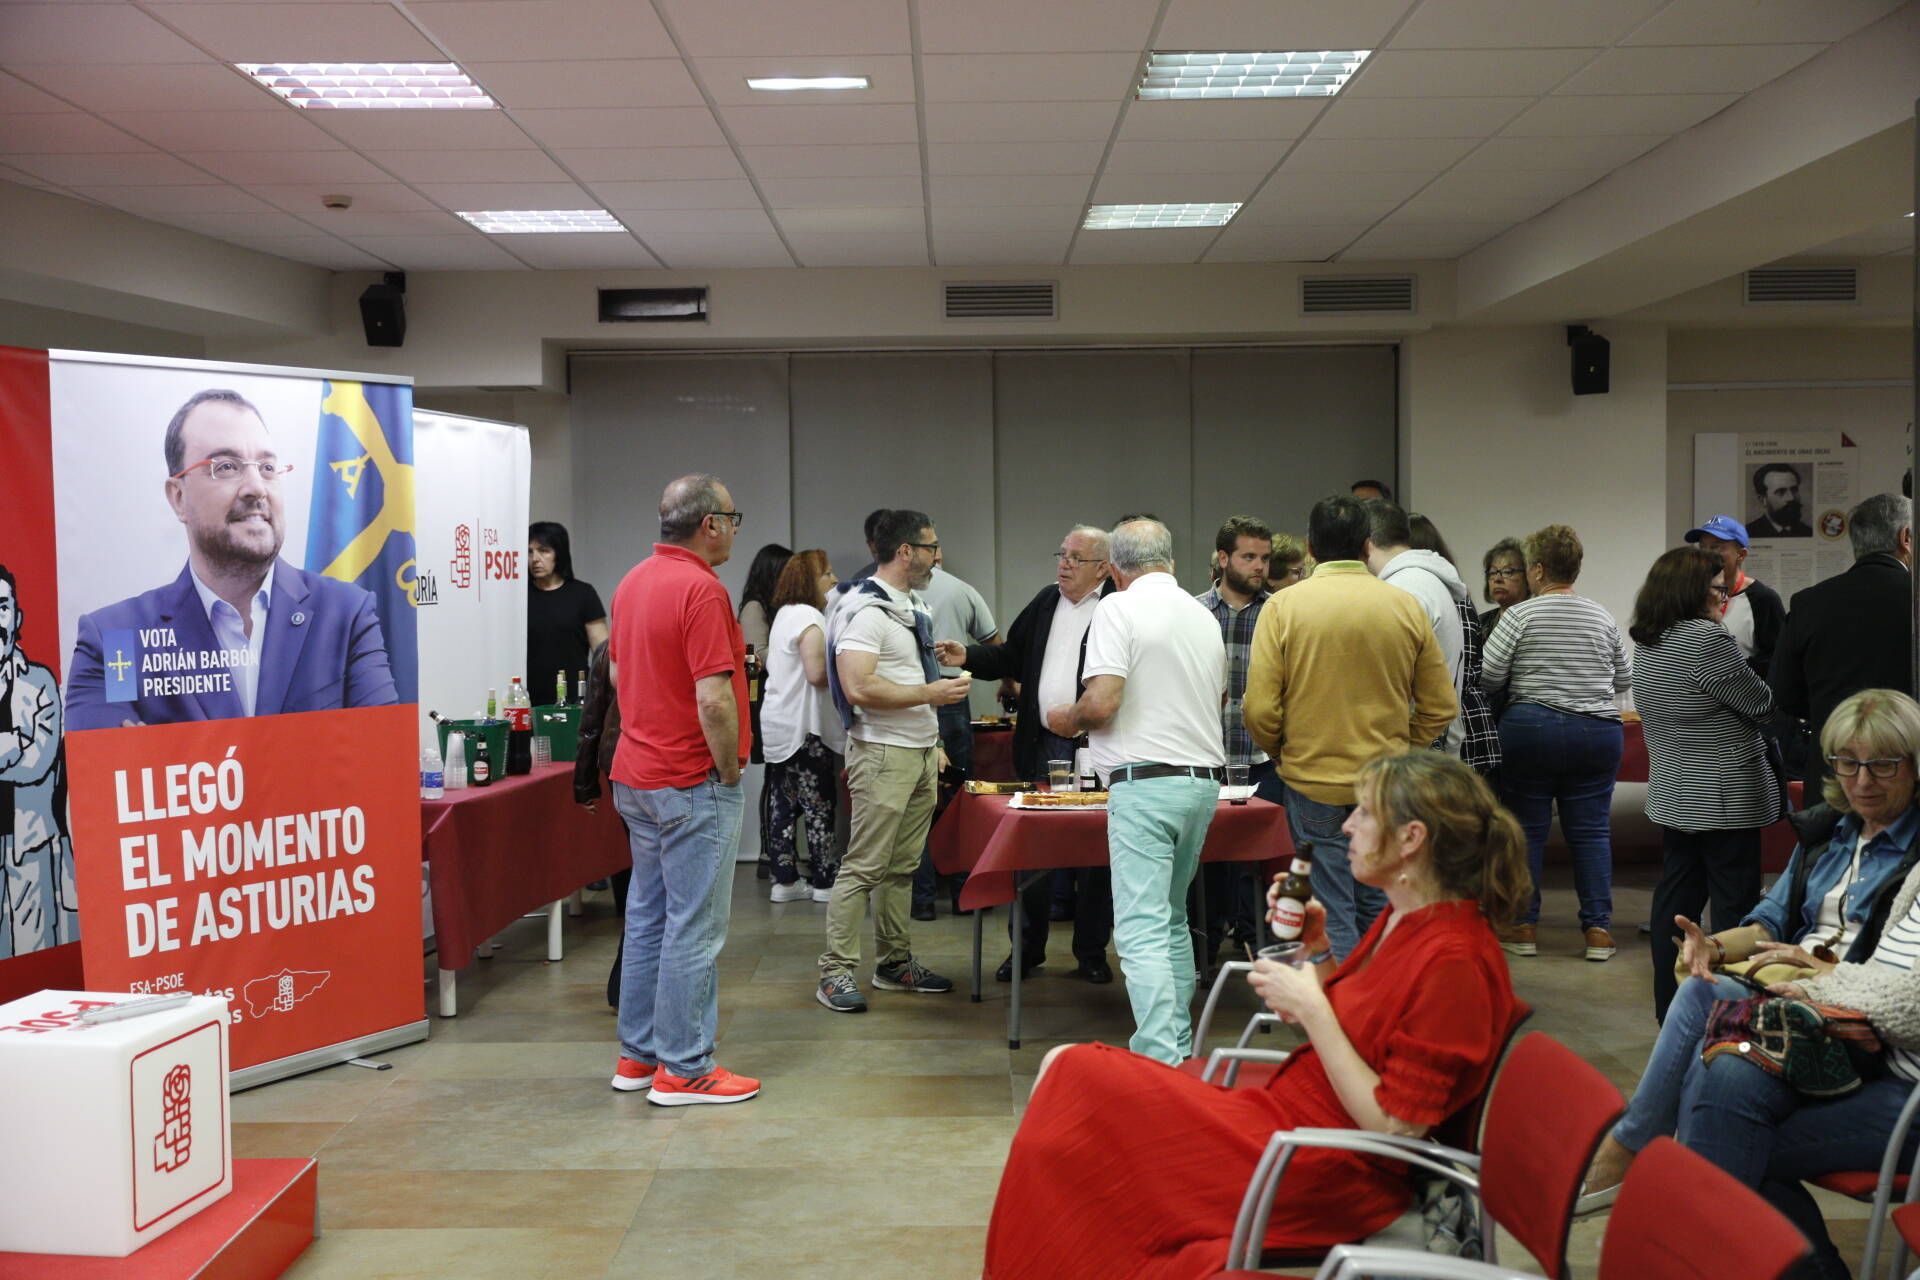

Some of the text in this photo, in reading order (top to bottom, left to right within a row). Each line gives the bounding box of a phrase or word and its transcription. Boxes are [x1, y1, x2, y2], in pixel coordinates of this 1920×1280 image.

[484, 528, 499, 546] FSA
[485, 551, 519, 580] PSOE
[139, 628, 177, 648] VOTA
[142, 644, 259, 673] ADRIÁN BARBÓN
[143, 673, 231, 697] PRESIDENTE
[114, 745, 244, 824] LLEGÓ
[120, 805, 365, 891] EL MOMENTO
[125, 864, 375, 958] DE ASTURIAS
[130, 972, 185, 995] FSA-PSOE
